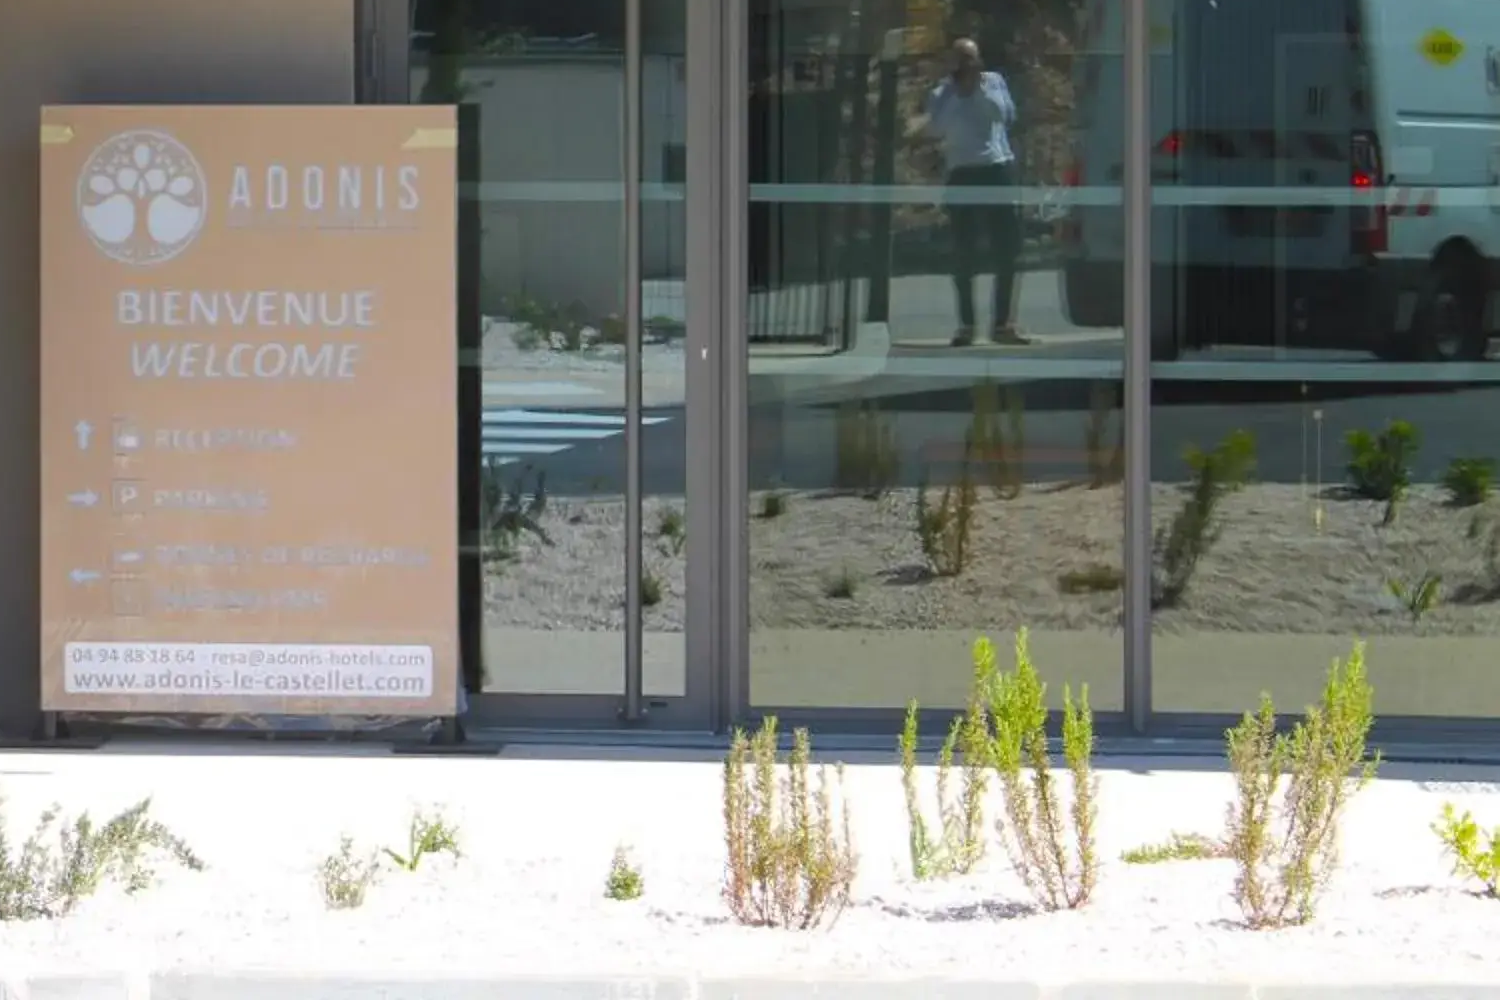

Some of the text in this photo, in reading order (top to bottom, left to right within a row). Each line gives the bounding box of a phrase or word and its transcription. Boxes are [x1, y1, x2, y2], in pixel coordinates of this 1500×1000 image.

[229, 165, 420, 210] ADONIS
[117, 290, 376, 326] BIENVENUE
[131, 342, 361, 378] WELCOME
[72, 647, 93, 664] 04
[97, 647, 119, 664] 94
[175, 648, 195, 664] 64
[73, 668, 426, 692] www.adonis-le-castellet.com
